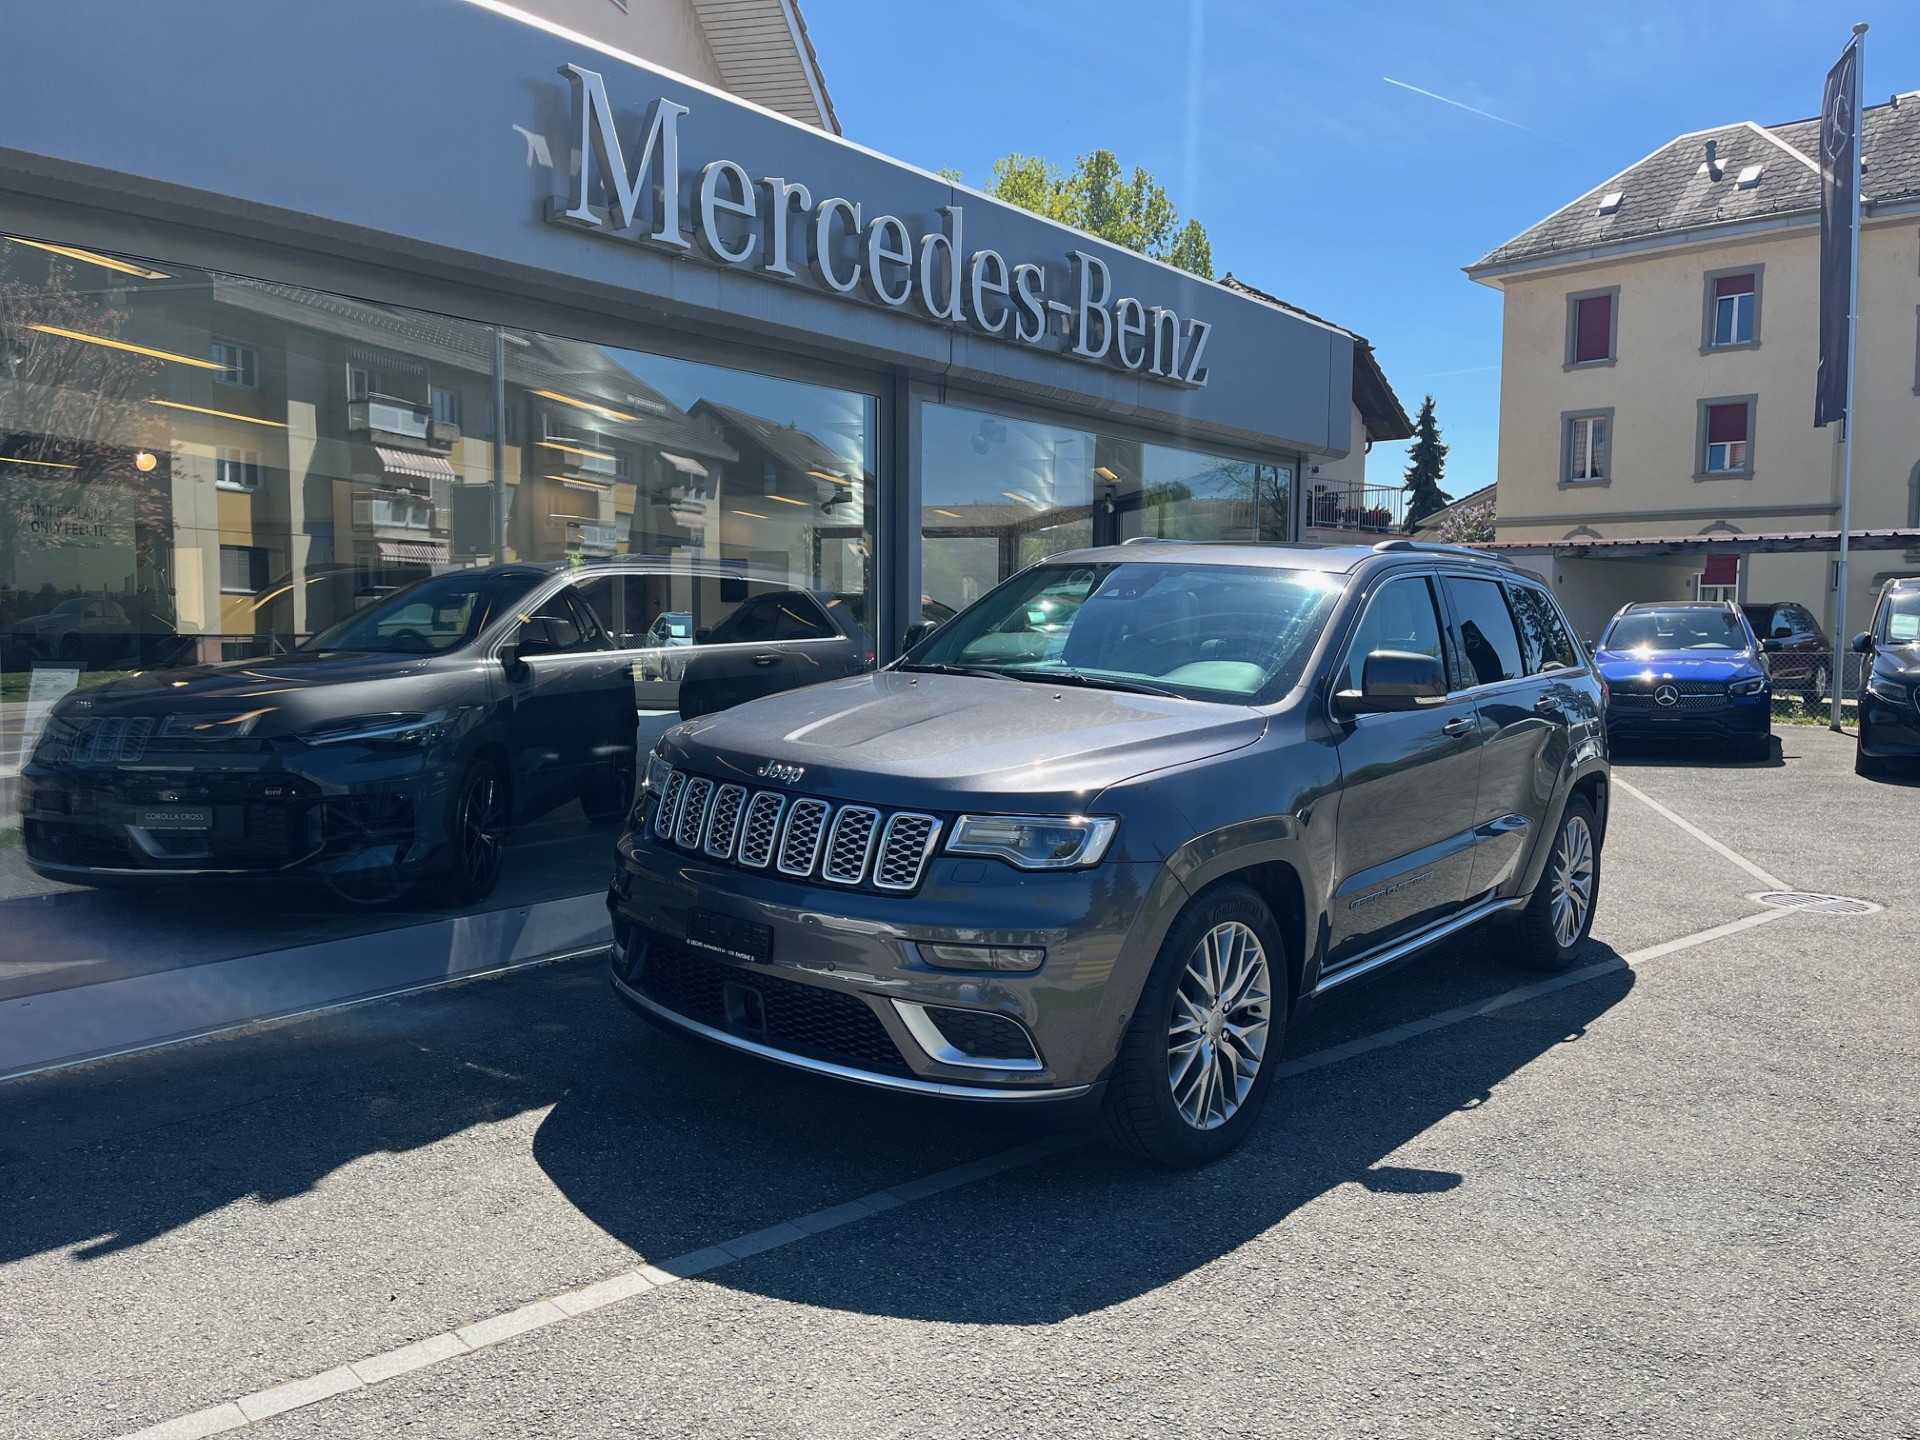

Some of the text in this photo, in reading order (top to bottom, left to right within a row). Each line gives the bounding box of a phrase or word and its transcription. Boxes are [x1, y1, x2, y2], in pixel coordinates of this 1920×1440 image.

[558, 62, 1212, 389] Mercedes-Benz
[30, 520, 62, 534] ONLY
[65, 522, 93, 537] FEEL
[756, 759, 805, 786] Jeep
[144, 812, 205, 821] COROLLA CROSS
